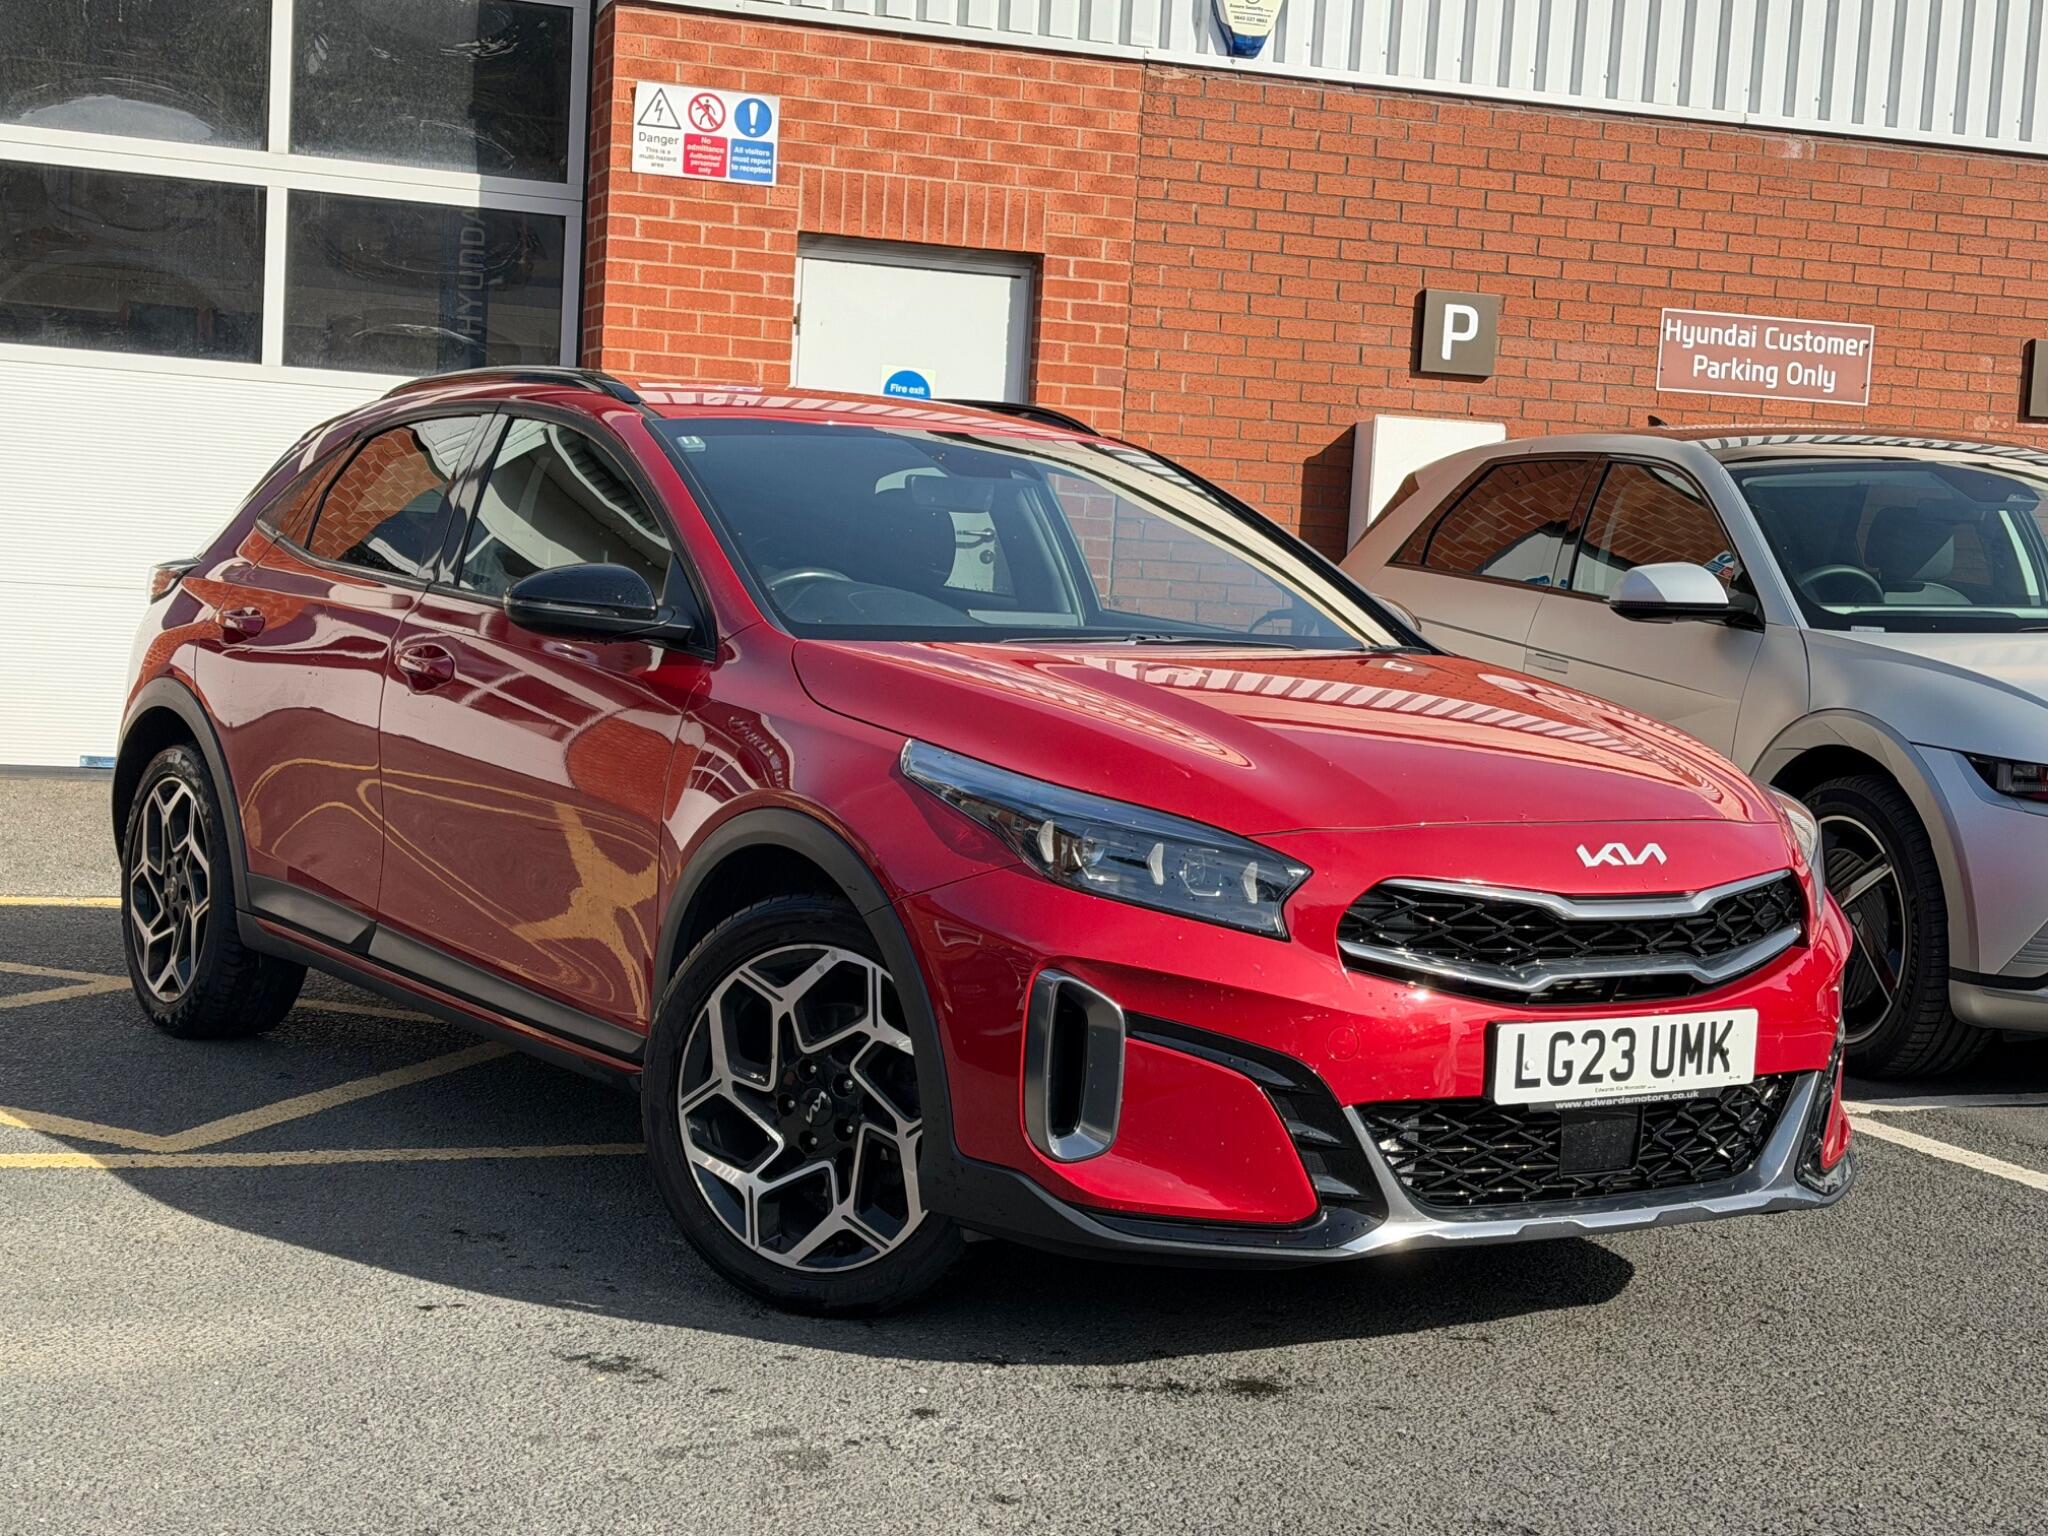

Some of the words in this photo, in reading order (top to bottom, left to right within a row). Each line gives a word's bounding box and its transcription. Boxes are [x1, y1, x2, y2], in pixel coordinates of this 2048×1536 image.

[638, 131, 680, 147] Danger
[701, 137, 712, 145] No
[687, 144, 725, 154] admittance
[734, 146, 744, 154] All
[745, 147, 770, 156] visitors
[740, 165, 772, 175] reception
[751, 157, 771, 166] report
[456, 208, 486, 335] HYUNDA
[1441, 303, 1479, 360] P
[1665, 318, 1757, 348] Hyundai
[1765, 327, 1869, 357] Customer
[1693, 354, 1779, 389] Parking
[1786, 361, 1836, 393] Only
[890, 383, 907, 393] Fire
[909, 387, 925, 395] exit
[1576, 842, 1667, 868] KIA
[1514, 1027, 1637, 1089] LG23
[1650, 1019, 1734, 1079] UMK
[1555, 1090, 1699, 1109] www.edwardsmotors.co.uk
